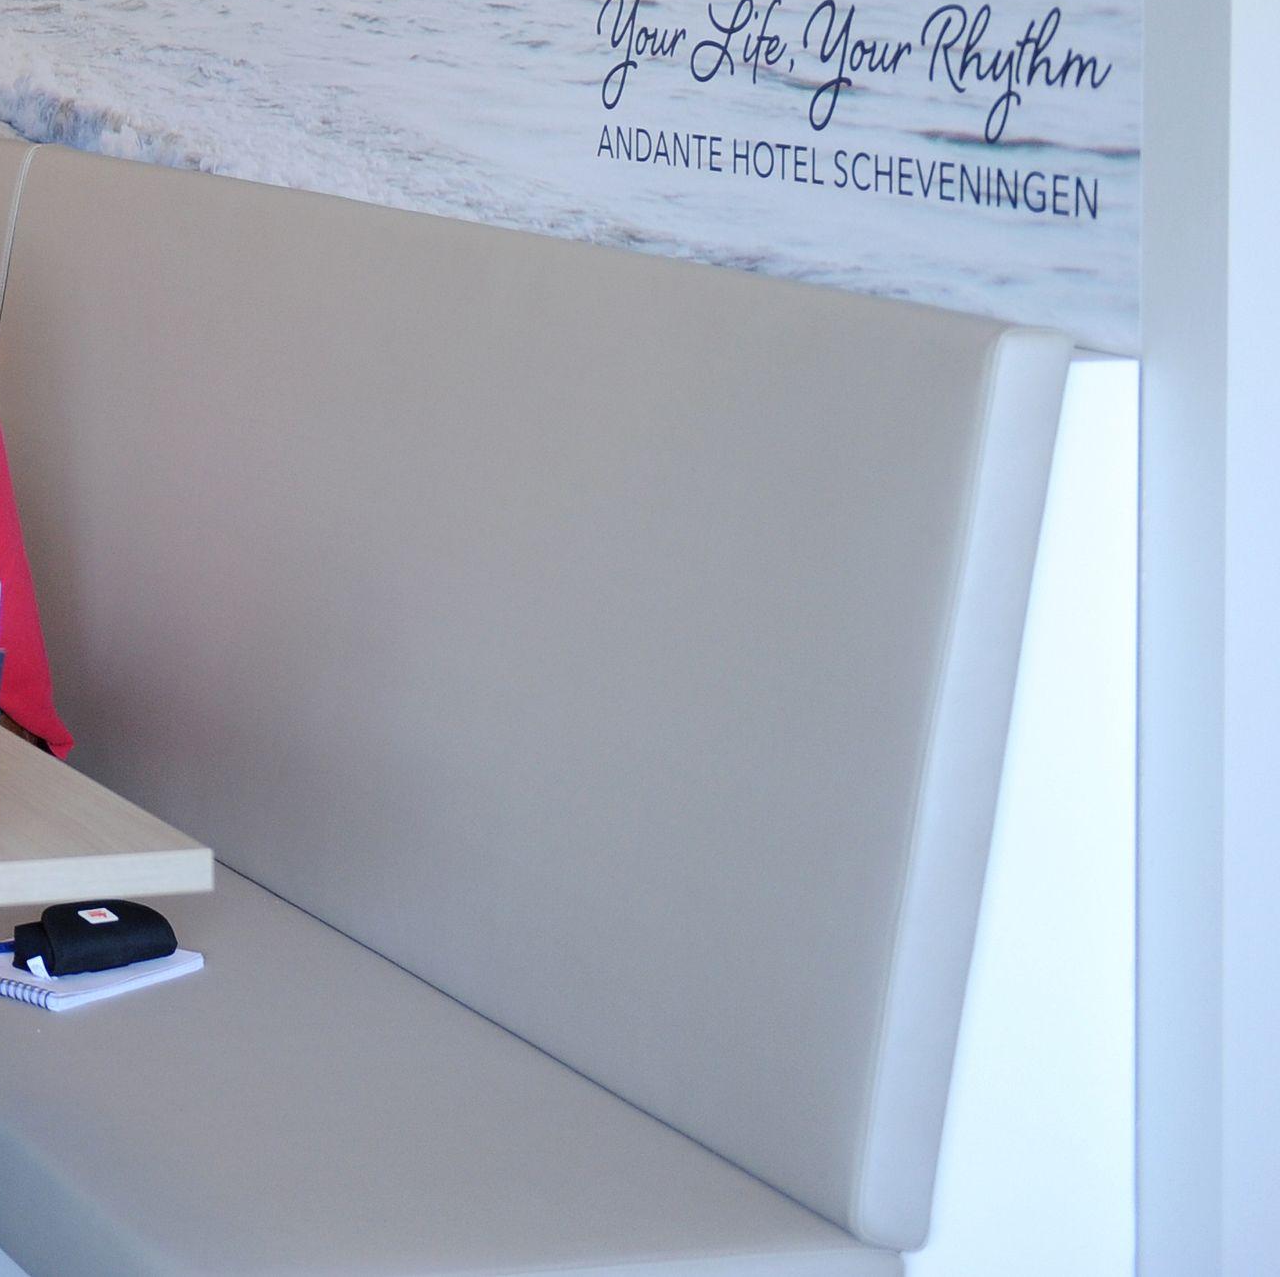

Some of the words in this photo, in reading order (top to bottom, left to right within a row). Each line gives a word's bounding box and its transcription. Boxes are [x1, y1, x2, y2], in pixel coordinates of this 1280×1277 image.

[803, 0, 912, 132] Your
[920, 4, 1112, 144] Rhythm
[597, 124, 724, 172] ANDANTE
[733, 139, 825, 186] HOTEL
[834, 150, 1099, 221] SCHEVENINGEN
